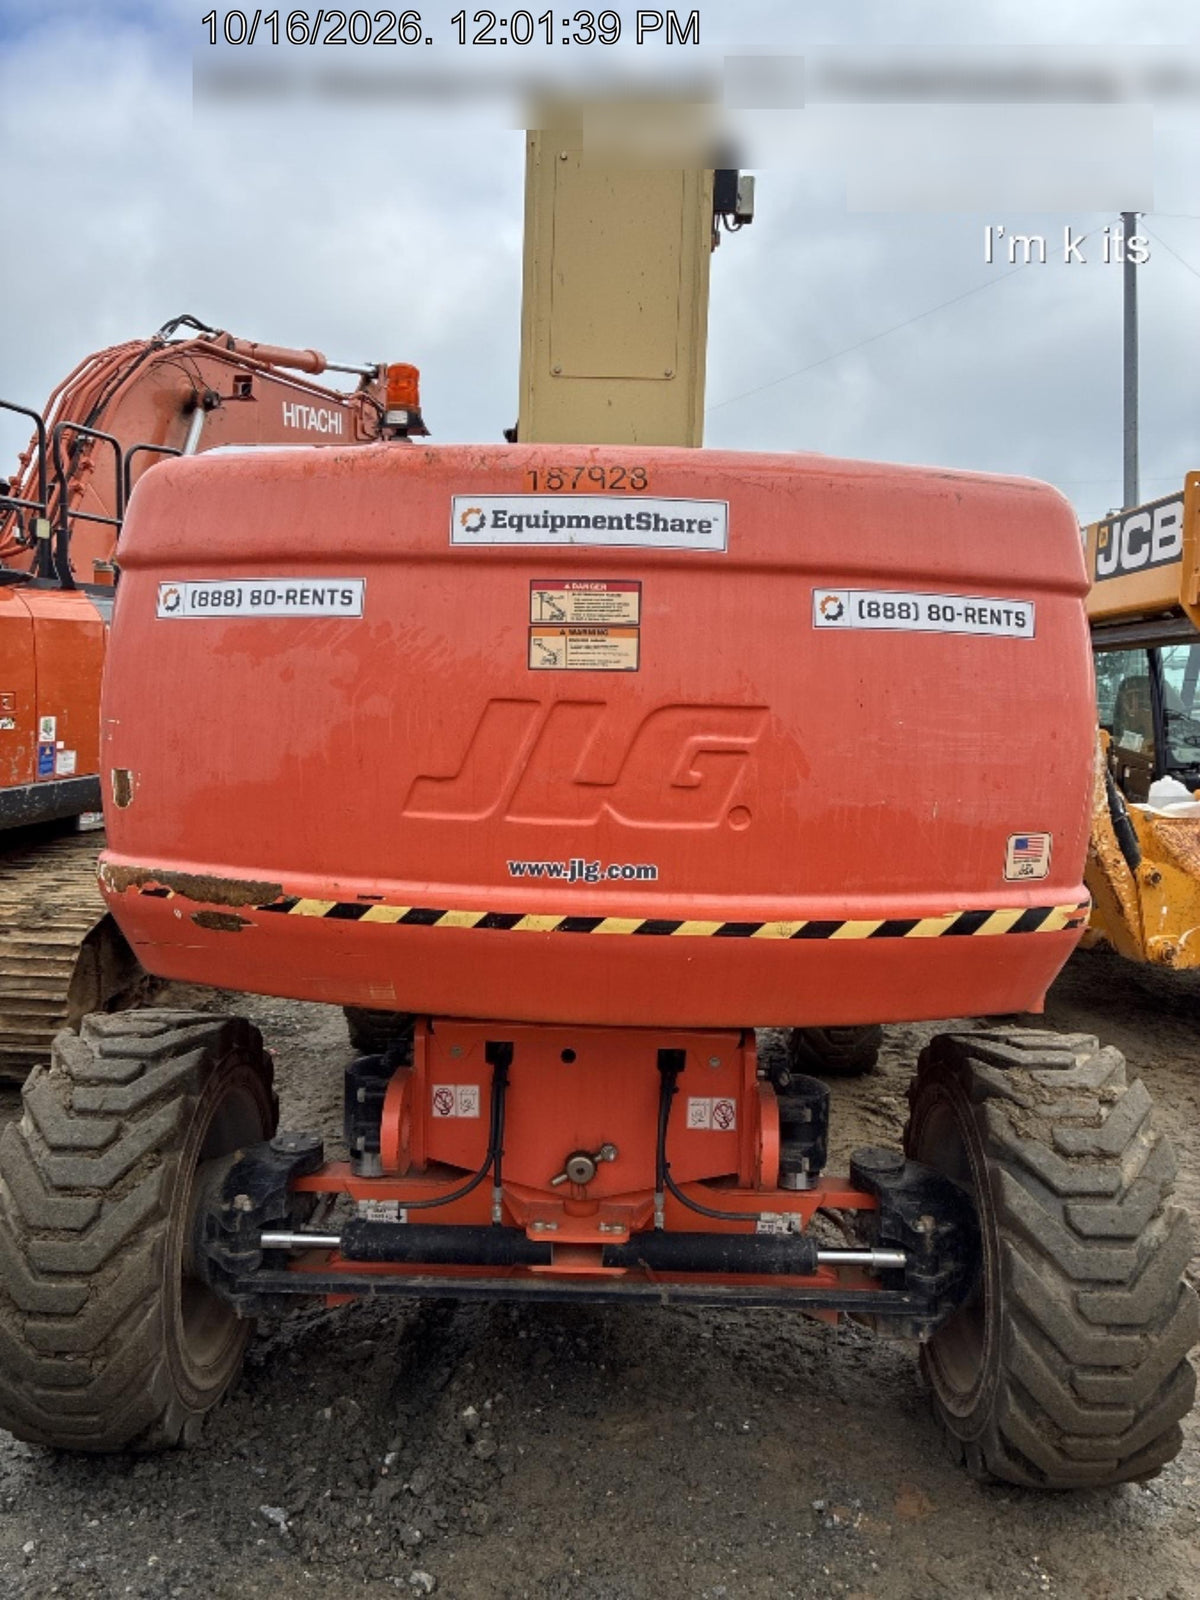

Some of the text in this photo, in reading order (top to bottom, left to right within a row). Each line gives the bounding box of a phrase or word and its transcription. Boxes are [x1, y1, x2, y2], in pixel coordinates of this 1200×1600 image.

[282, 401, 343, 435] HITACHI
[527, 465, 648, 491] 187928
[1097, 501, 1184, 575] JCB
[191, 588, 354, 608] (888) 80-RENTS
[571, 582, 607, 591] DANGER
[858, 599, 1026, 628] (888) 80-RENTS
[568, 628, 608, 636] WARNING
[507, 858, 659, 883] www.jlg.com
